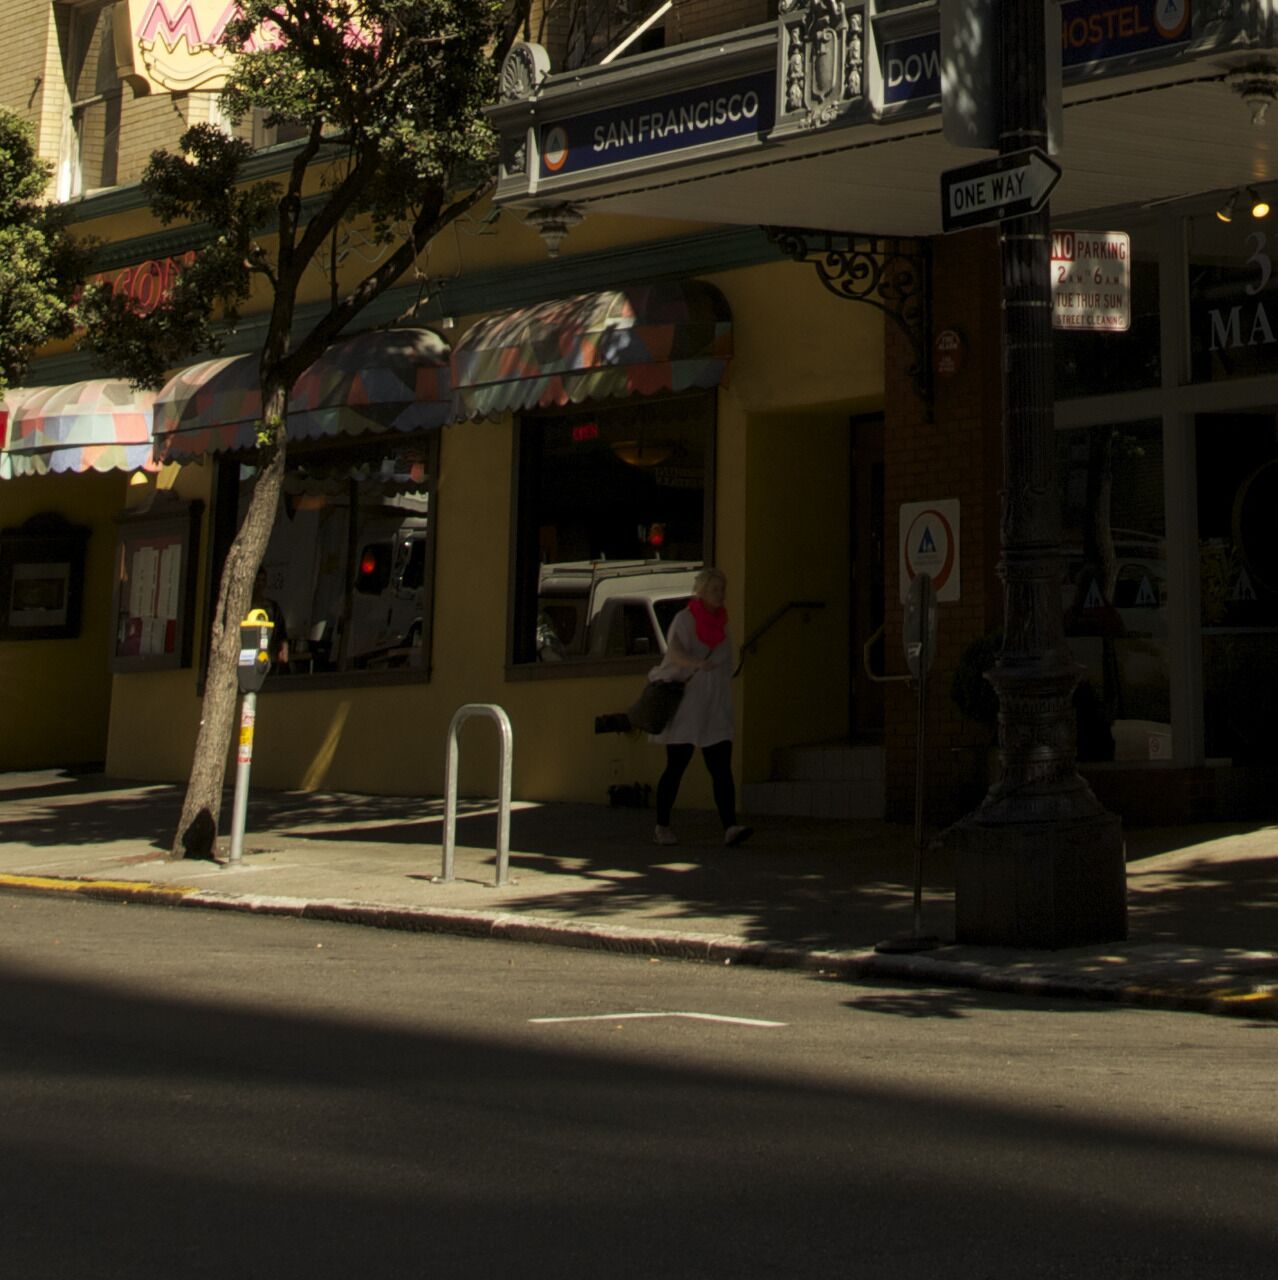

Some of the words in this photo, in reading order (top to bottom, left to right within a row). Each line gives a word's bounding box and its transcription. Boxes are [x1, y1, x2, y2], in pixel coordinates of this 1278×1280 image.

[593, 120, 634, 152] SAN
[638, 91, 759, 140] FRANCISCO
[954, 182, 986, 210] ONE
[992, 171, 1025, 201] WAY
[1051, 234, 1074, 258] NO
[1077, 241, 1126, 260] PARKING
[1058, 266, 1066, 284] 2
[1094, 267, 1102, 285] 6
[1056, 292, 1074, 308] TUE
[1076, 293, 1101, 309] THUR
[1103, 294, 1122, 309] SUN
[1056, 314, 1085, 325] STREET
